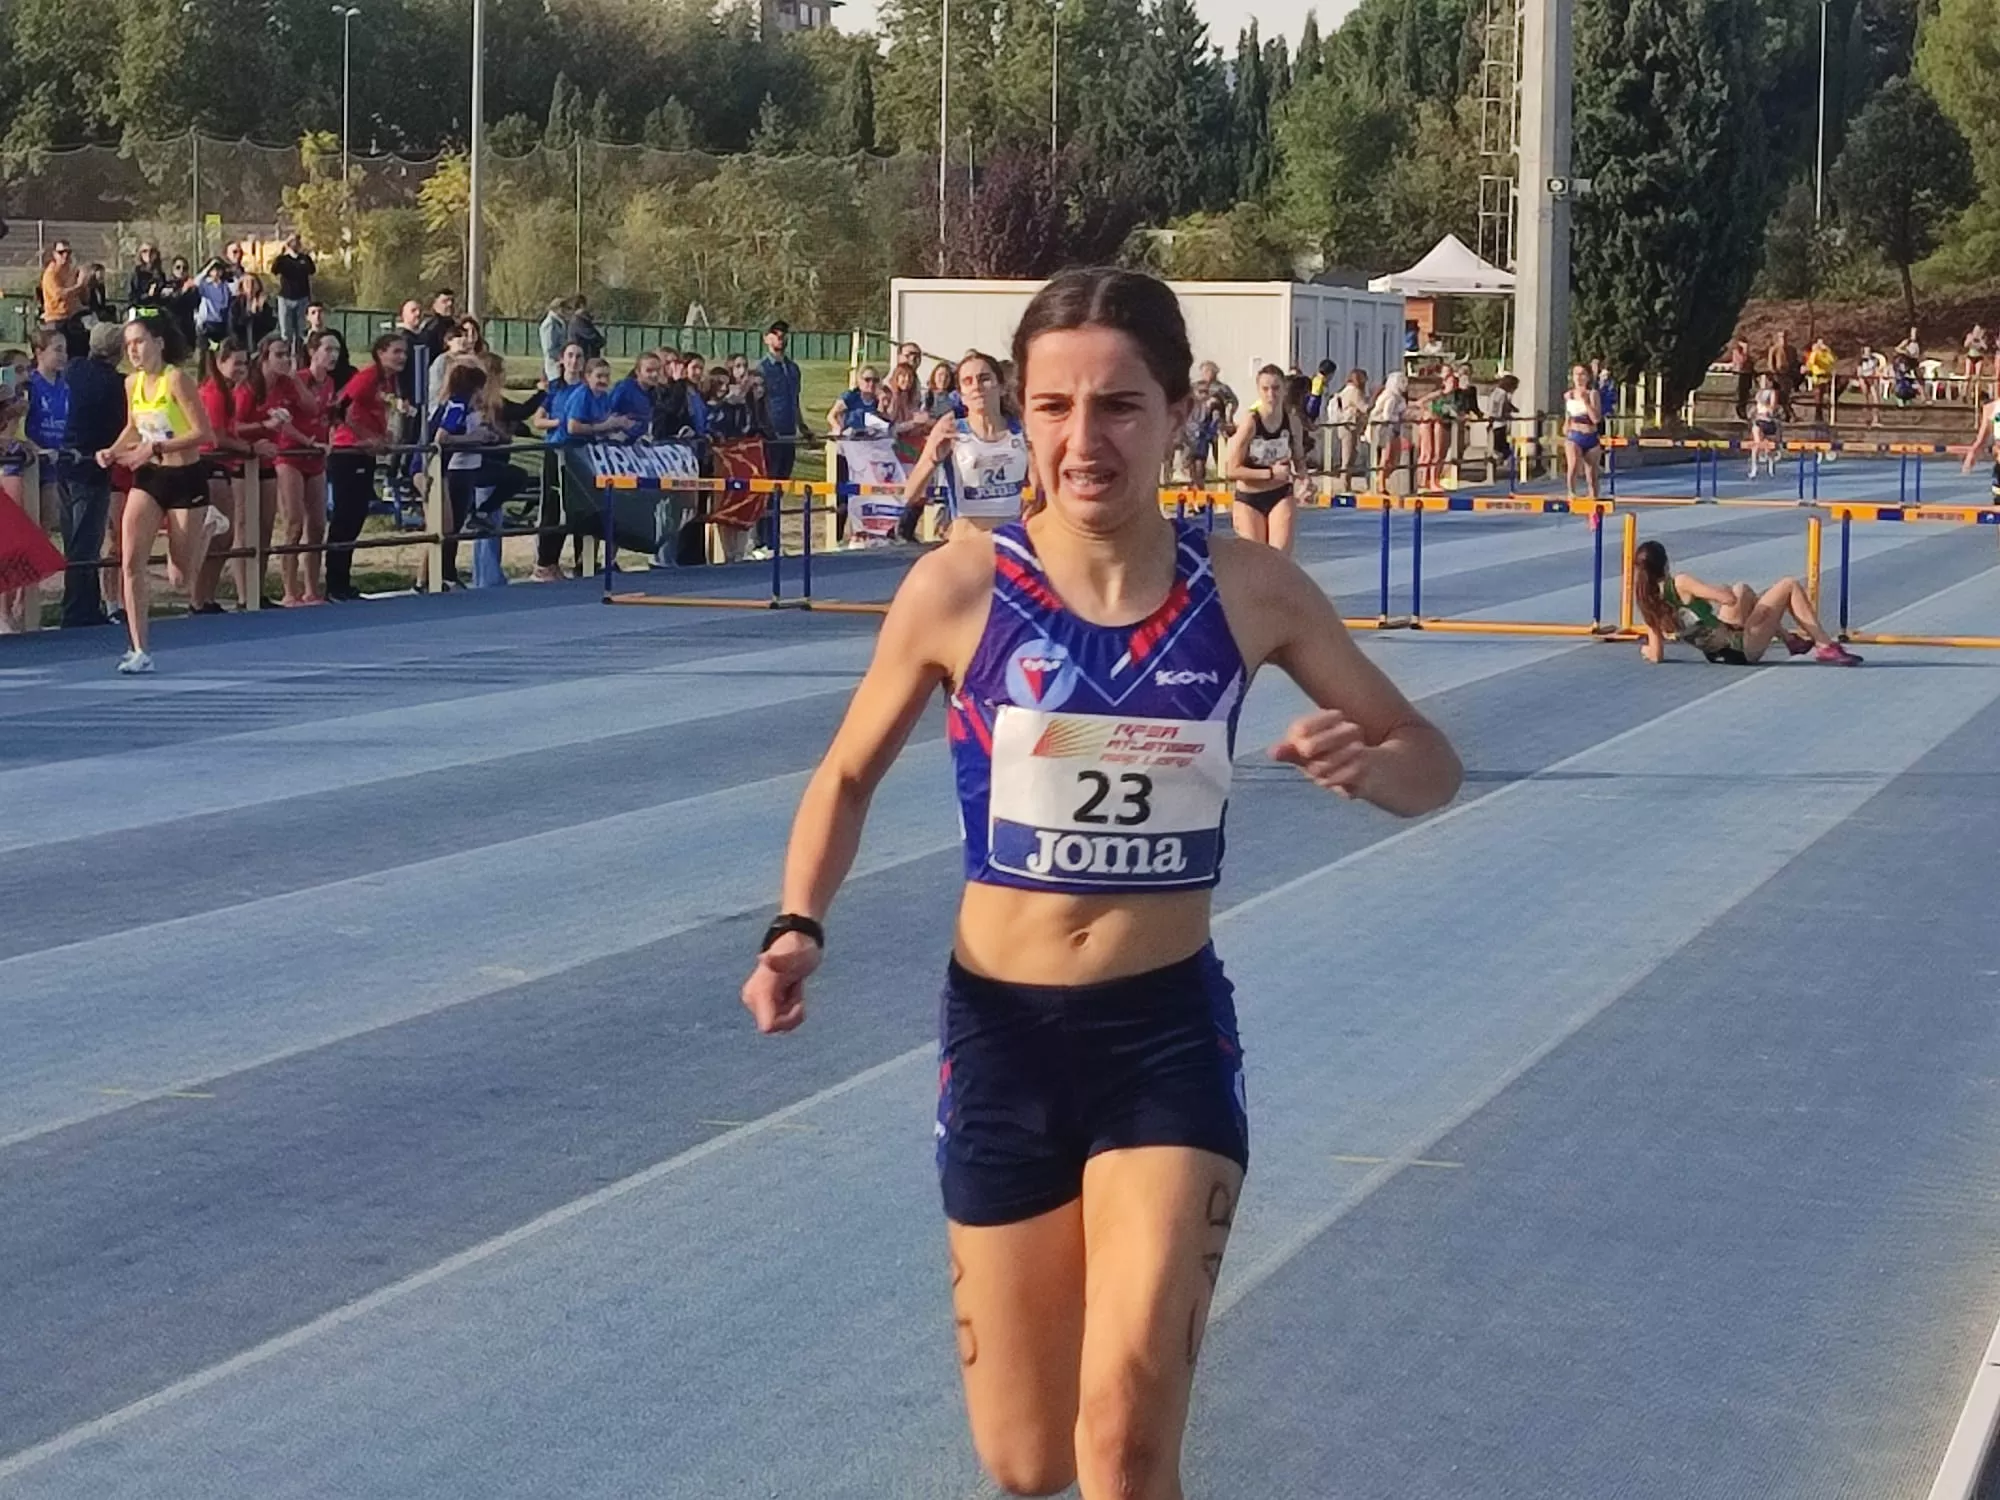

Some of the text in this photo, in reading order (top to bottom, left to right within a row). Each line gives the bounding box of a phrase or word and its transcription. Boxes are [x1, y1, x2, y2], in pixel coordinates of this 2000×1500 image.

[983, 465, 1005, 484] 24
[1072, 770, 1153, 825] 23
[1026, 830, 1187, 875] Joma
